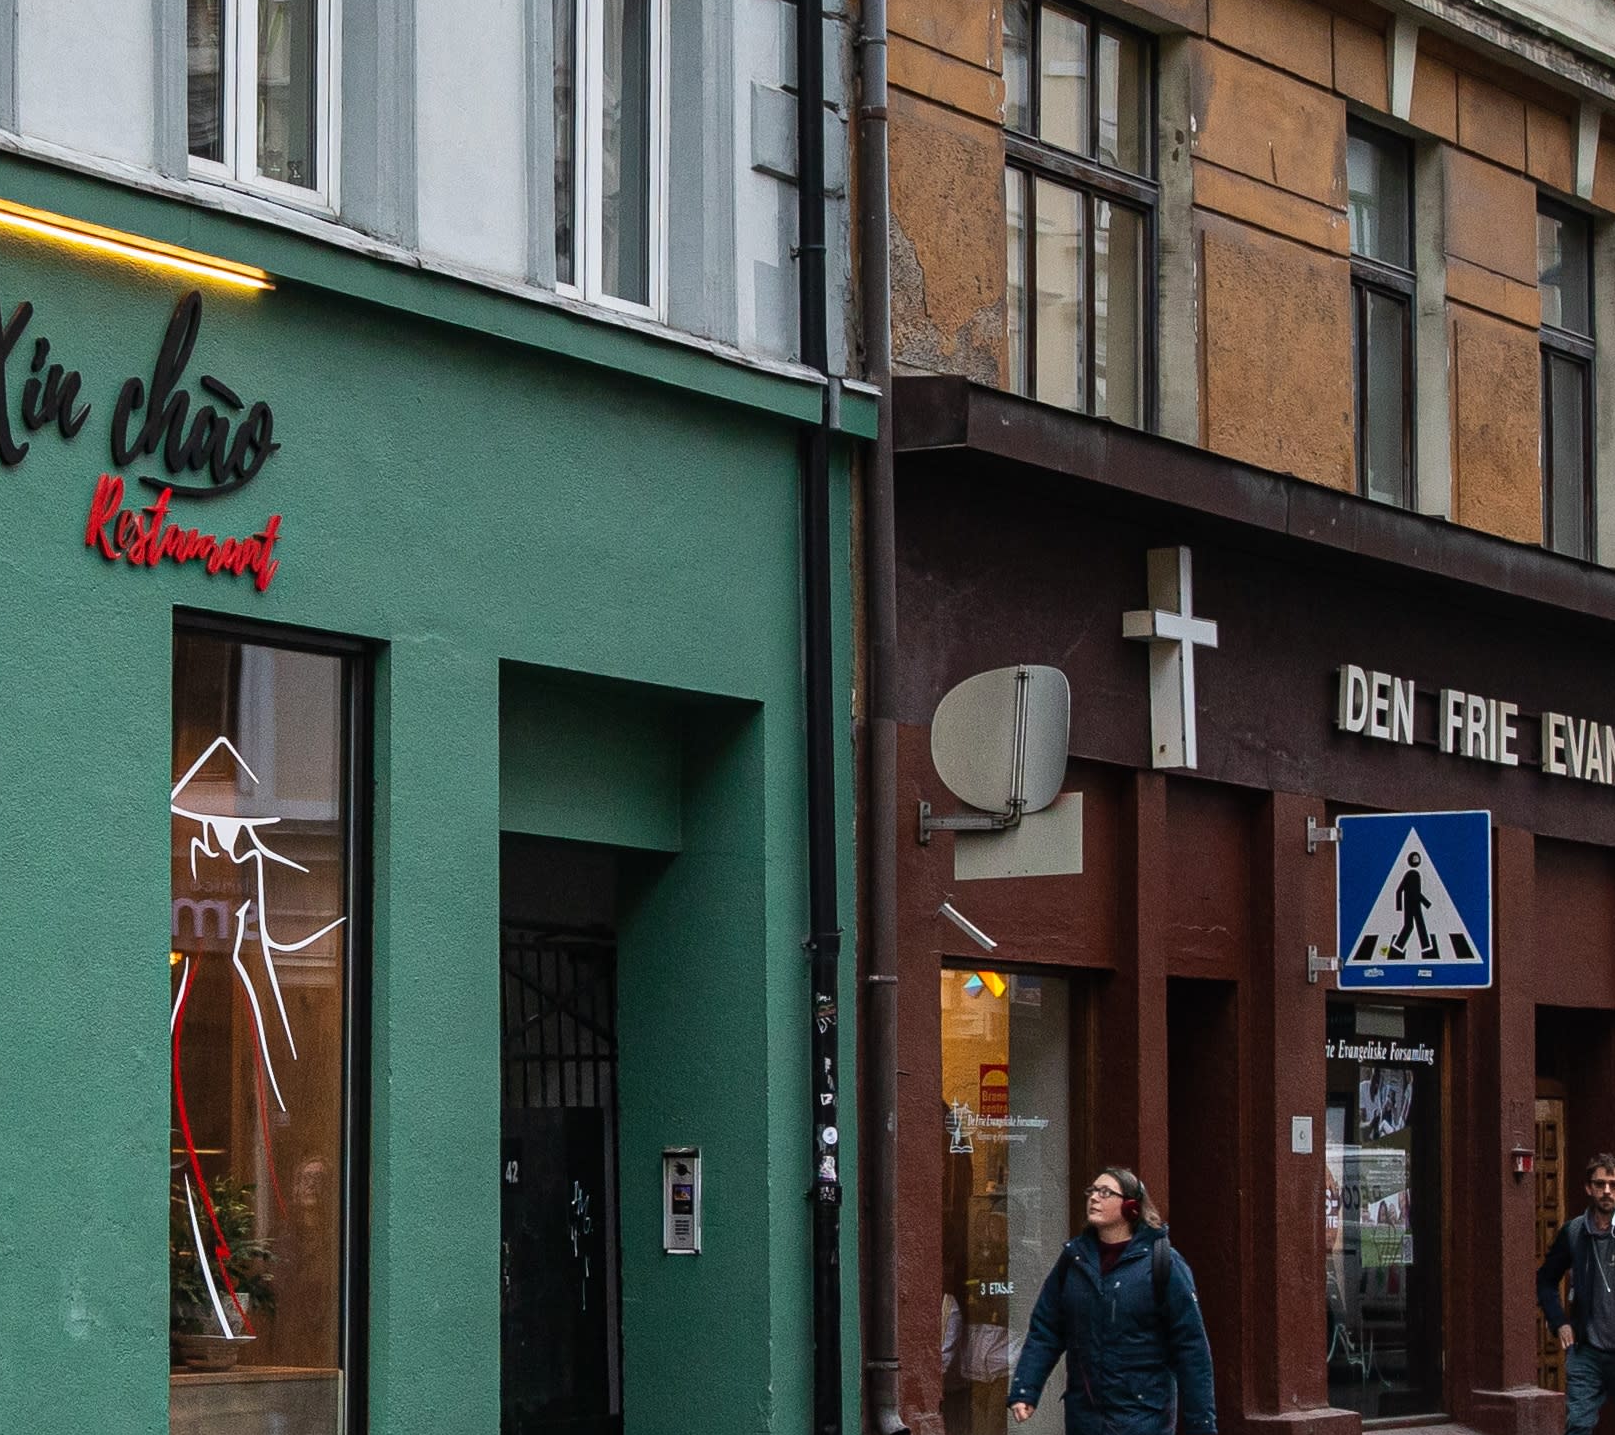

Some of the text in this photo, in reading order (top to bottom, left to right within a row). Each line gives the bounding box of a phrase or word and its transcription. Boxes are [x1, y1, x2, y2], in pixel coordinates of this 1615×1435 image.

[111, 291, 282, 498] chào
[85, 473, 283, 592] Restaurant
[1339, 664, 1415, 745] DEN
[1439, 688, 1519, 767] FRIE
[1338, 1039, 1387, 1063] Evangeliske
[1390, 1042, 1435, 1066] Forsamling
[505, 1160, 519, 1184] 42
[980, 1281, 1015, 1296] 3 ETASJE
